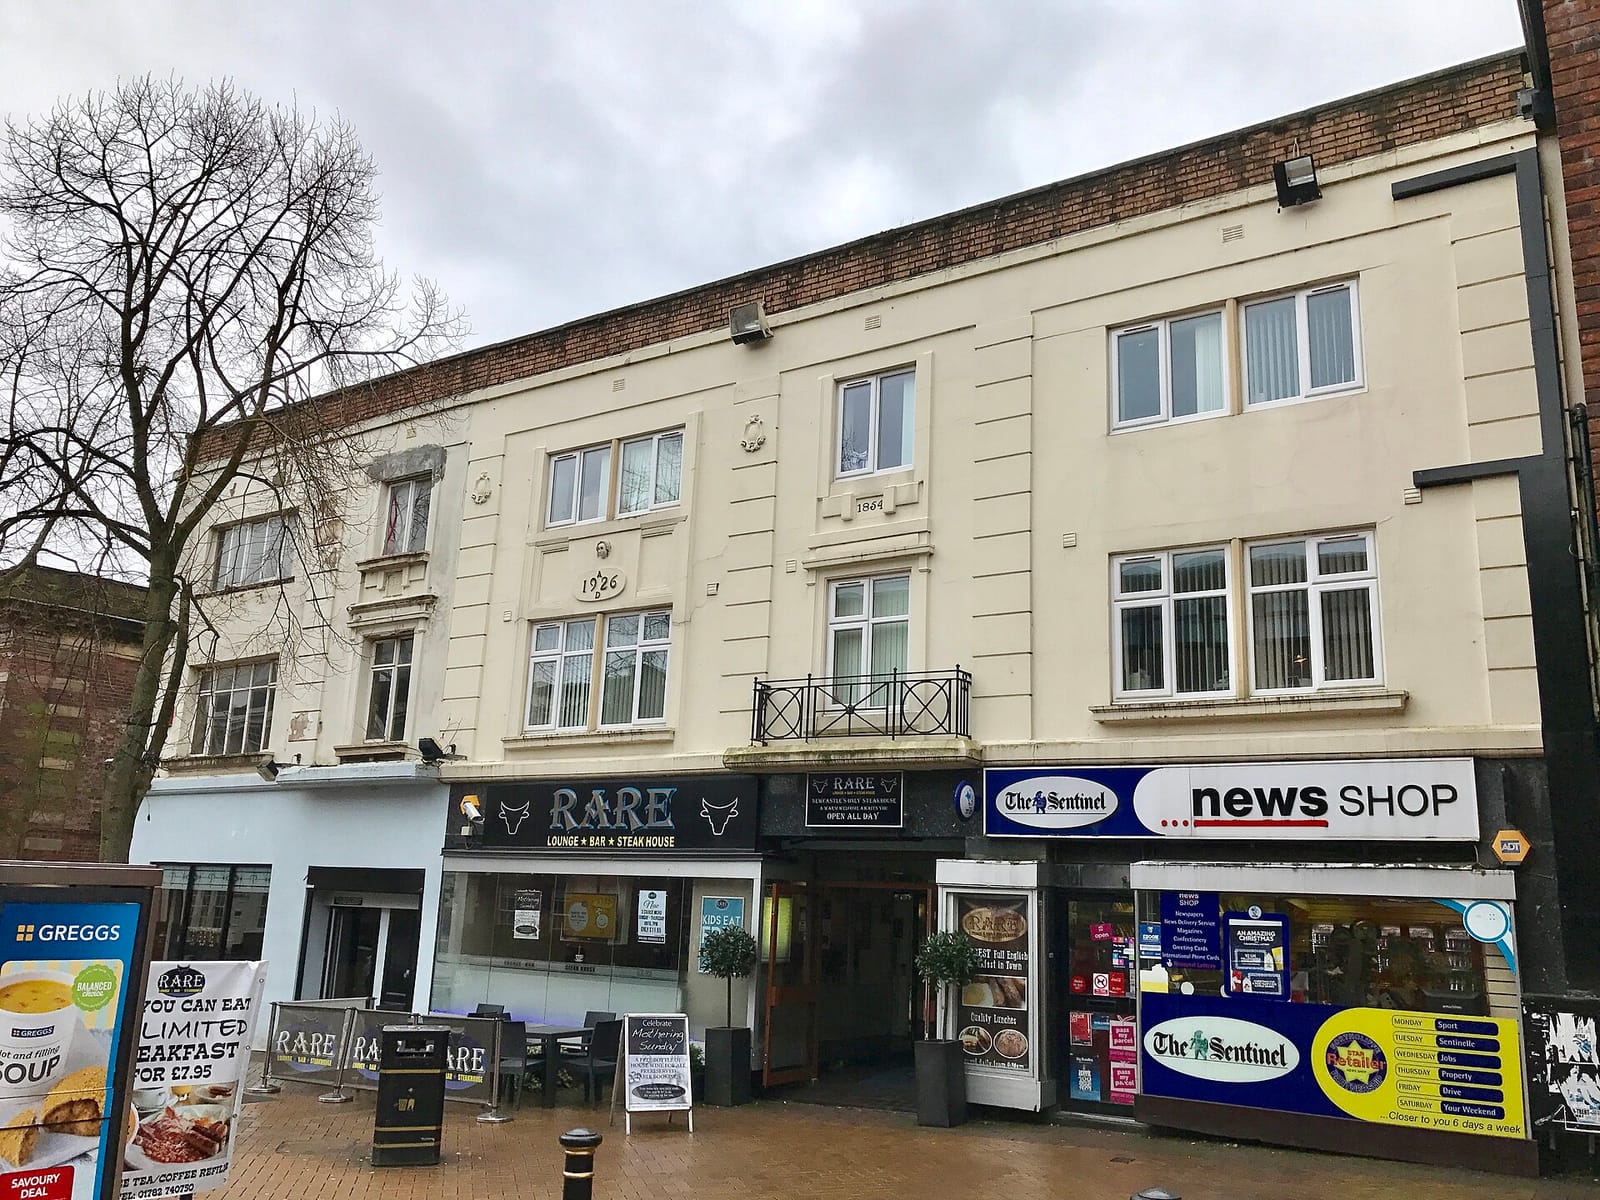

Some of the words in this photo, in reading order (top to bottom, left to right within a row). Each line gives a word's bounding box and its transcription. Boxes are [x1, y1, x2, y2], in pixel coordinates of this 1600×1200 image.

[597, 570, 602, 578] A
[582, 574, 618, 593] 1926
[595, 591, 601, 599] D
[834, 777, 875, 790] RARE
[1005, 791, 1033, 811] The
[1047, 791, 1107, 811] Sentinel
[1192, 786, 1329, 818] news
[1339, 784, 1458, 816] SHOP
[549, 786, 678, 834] RARE
[826, 812, 846, 820] OPEN
[847, 812, 862, 820] ALL
[862, 812, 879, 820] DAY
[547, 835, 579, 847] LOUNGE
[589, 836, 606, 847] BAR
[617, 836, 644, 848] STEAK
[645, 837, 675, 848] HOUSE
[1501, 839, 1521, 851] ADT
[1179, 899, 1200, 907] SHOP
[702, 914, 721, 925] KIDS
[723, 915, 741, 926] EAT
[1175, 910, 1204, 918] Newspapers
[38, 924, 121, 941] GREGGS
[1177, 927, 1203, 935] Magazines
[1173, 936, 1207, 944] Confectionery
[1172, 944, 1194, 952] Greeting
[993, 950, 1005, 959] Full
[1161, 951, 1191, 959] International
[77, 981, 112, 992] BALANCED
[159, 974, 203, 988] RARE
[181, 999, 217, 1013] CAN
[642, 1019, 672, 1027] Celebrate
[970, 1012, 991, 1024] Quality
[993, 1013, 1016, 1025] Lunches
[1394, 1018, 1422, 1026] MONDAY
[1437, 1020, 1458, 1030] Sport
[20, 1027, 54, 1037] GREGGS
[632, 1028, 685, 1044] Mothering
[276, 1030, 336, 1057] RARE
[1395, 1034, 1423, 1043] TUESDAY
[1438, 1037, 1476, 1048] Sentinelle
[0, 1050, 11, 1058] ot
[12, 1051, 33, 1060] and
[34, 1045, 61, 1059] filling
[137, 1041, 239, 1062] EAKFAST
[353, 1036, 382, 1061] RA
[640, 1041, 677, 1055] Sunday
[1153, 1031, 1189, 1057] The
[1209, 1037, 1289, 1067] Sentinel
[1347, 1049, 1365, 1057] STAR
[1326, 1052, 1386, 1070] Retailer
[1396, 1050, 1436, 1060] WEDNESDAY
[1440, 1054, 1457, 1063] Jobs
[172, 1065, 212, 1081] £7.95
[1397, 1067, 1431, 1076] THURSDAY
[1441, 1070, 1472, 1081] Property
[1398, 1083, 1421, 1091] FRIDAY
[1442, 1086, 1462, 1096] Drive
[1399, 1099, 1433, 1109] SATURDAY
[1443, 1103, 1460, 1113] Your
[1462, 1105, 1496, 1116] Weekend
[1421, 1114, 1430, 1123] to
[1433, 1117, 1450, 1126] you
[1453, 1118, 1459, 1126] 6
[1462, 1120, 1485, 1131] days
[1495, 1124, 1521, 1134] week
[11, 1173, 60, 1188] SAVOURY
[133, 1169, 197, 1187] TEA/COFFEE
[20, 1186, 48, 1199] DEAL
[138, 1187, 162, 1199] 01782
[164, 1183, 195, 1196] 740750
